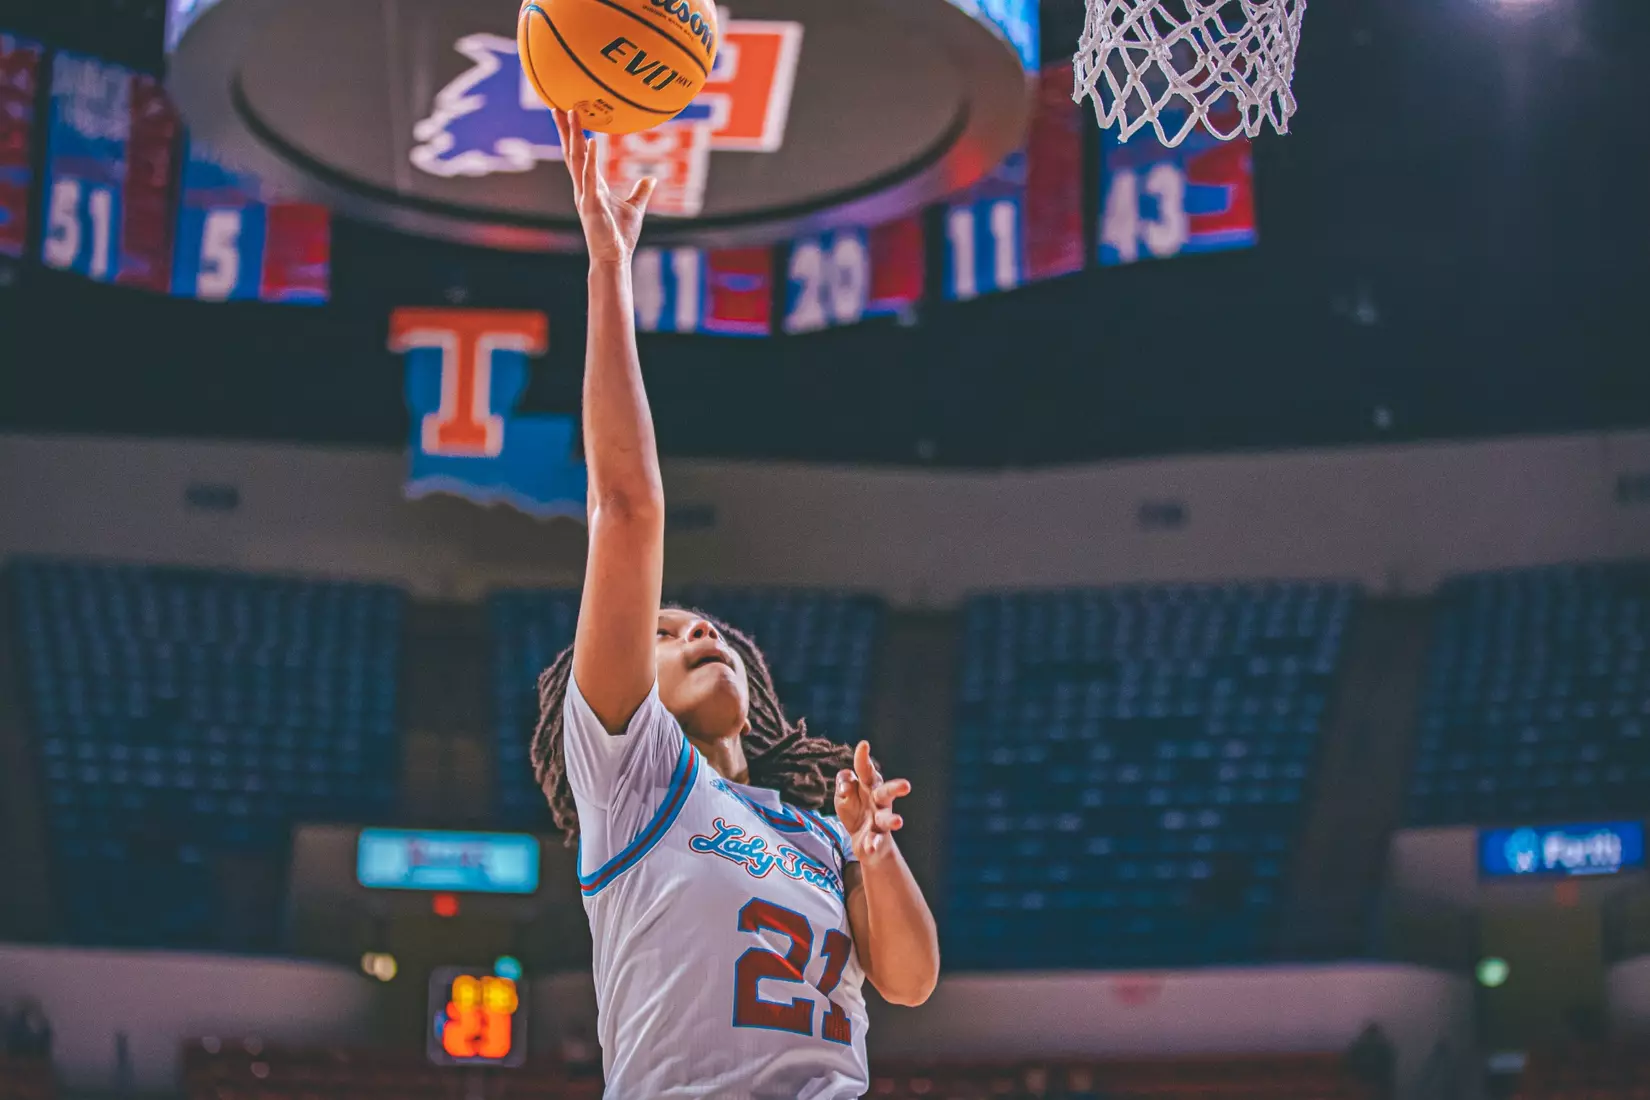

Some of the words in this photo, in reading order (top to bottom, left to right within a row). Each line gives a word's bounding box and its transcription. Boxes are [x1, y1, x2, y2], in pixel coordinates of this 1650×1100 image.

[600, 36, 679, 91] EVO
[45, 179, 111, 282] 51
[195, 208, 241, 302] 5
[948, 199, 1017, 301] 11
[1101, 163, 1188, 262] 43
[388, 306, 548, 458] T
[688, 817, 774, 879] Lady
[732, 896, 852, 1046] 21
